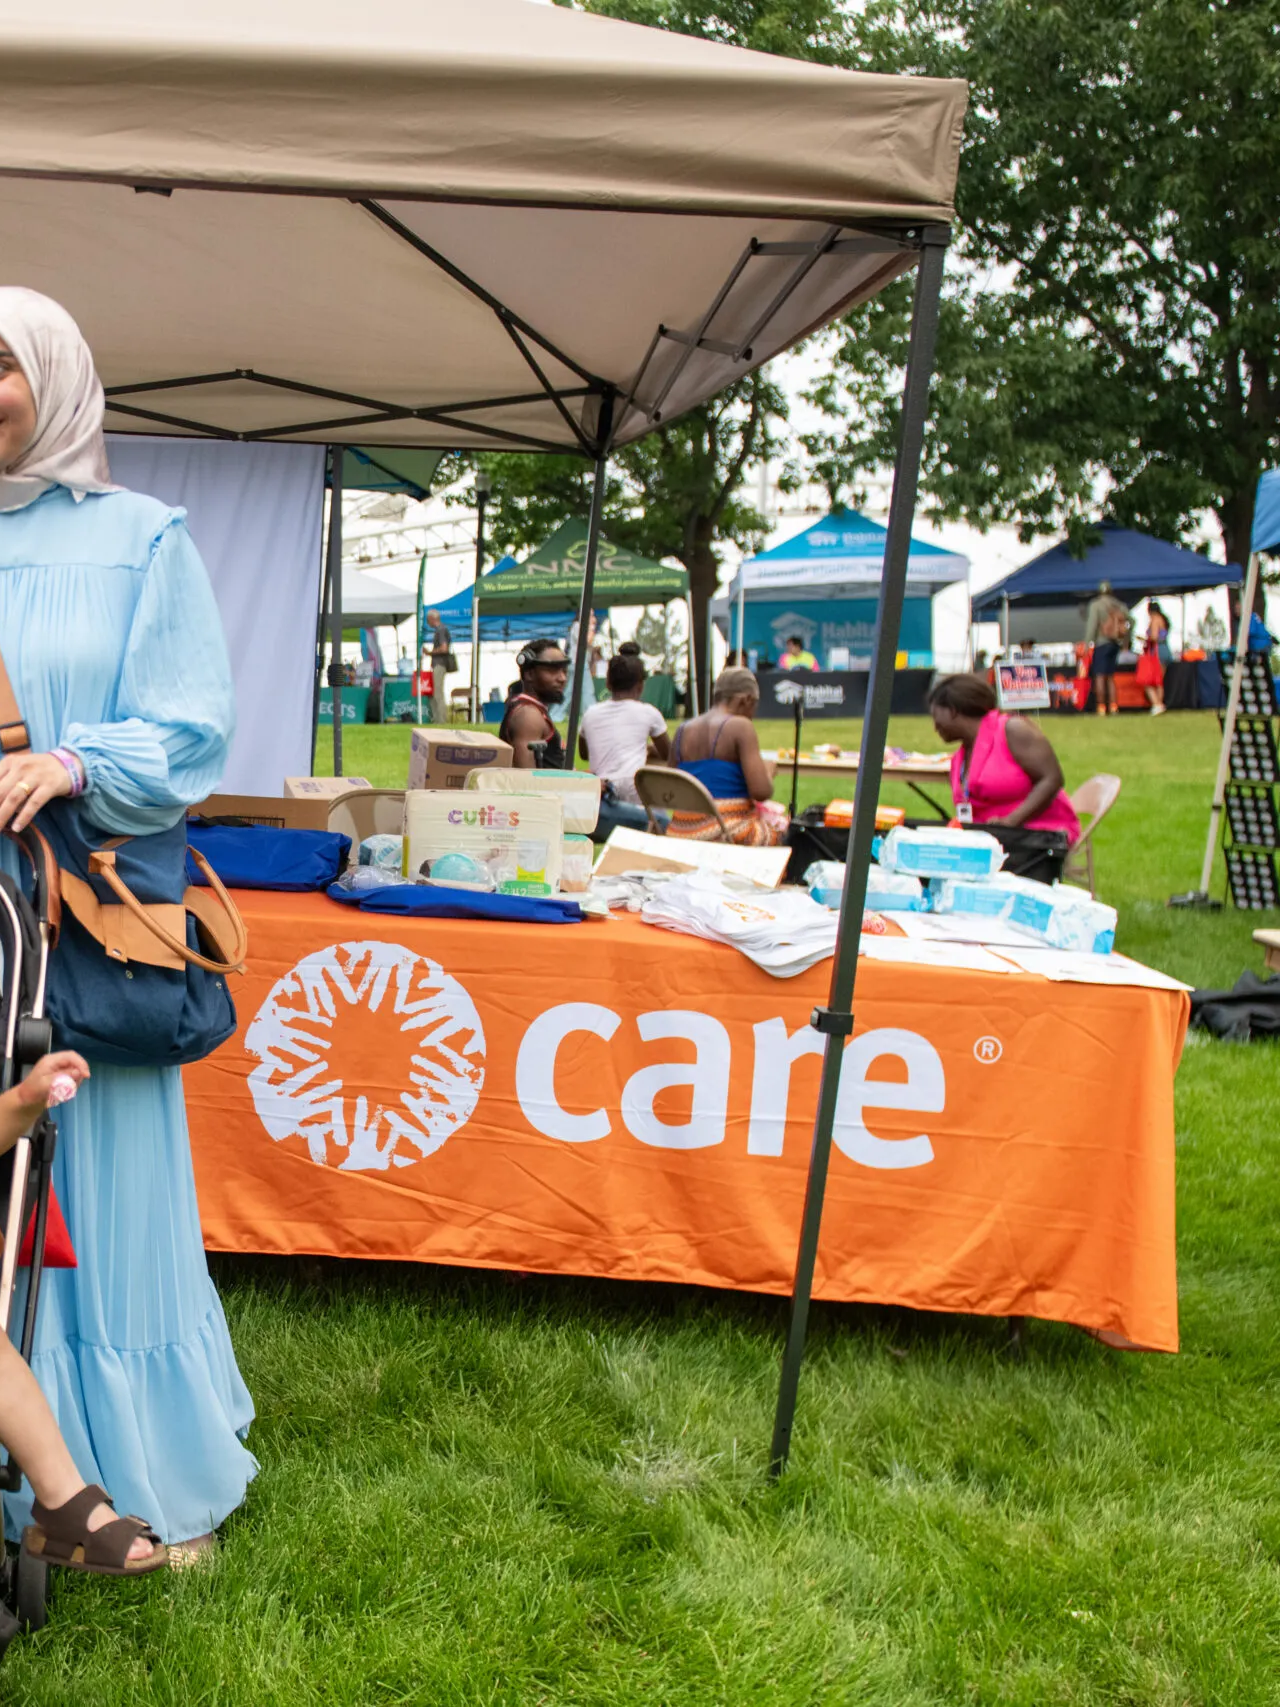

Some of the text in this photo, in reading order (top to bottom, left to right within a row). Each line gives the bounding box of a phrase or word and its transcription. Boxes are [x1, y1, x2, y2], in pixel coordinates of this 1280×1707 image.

[526, 556, 634, 575] NMC
[447, 805, 520, 827] cuties
[515, 1001, 946, 1170] care
